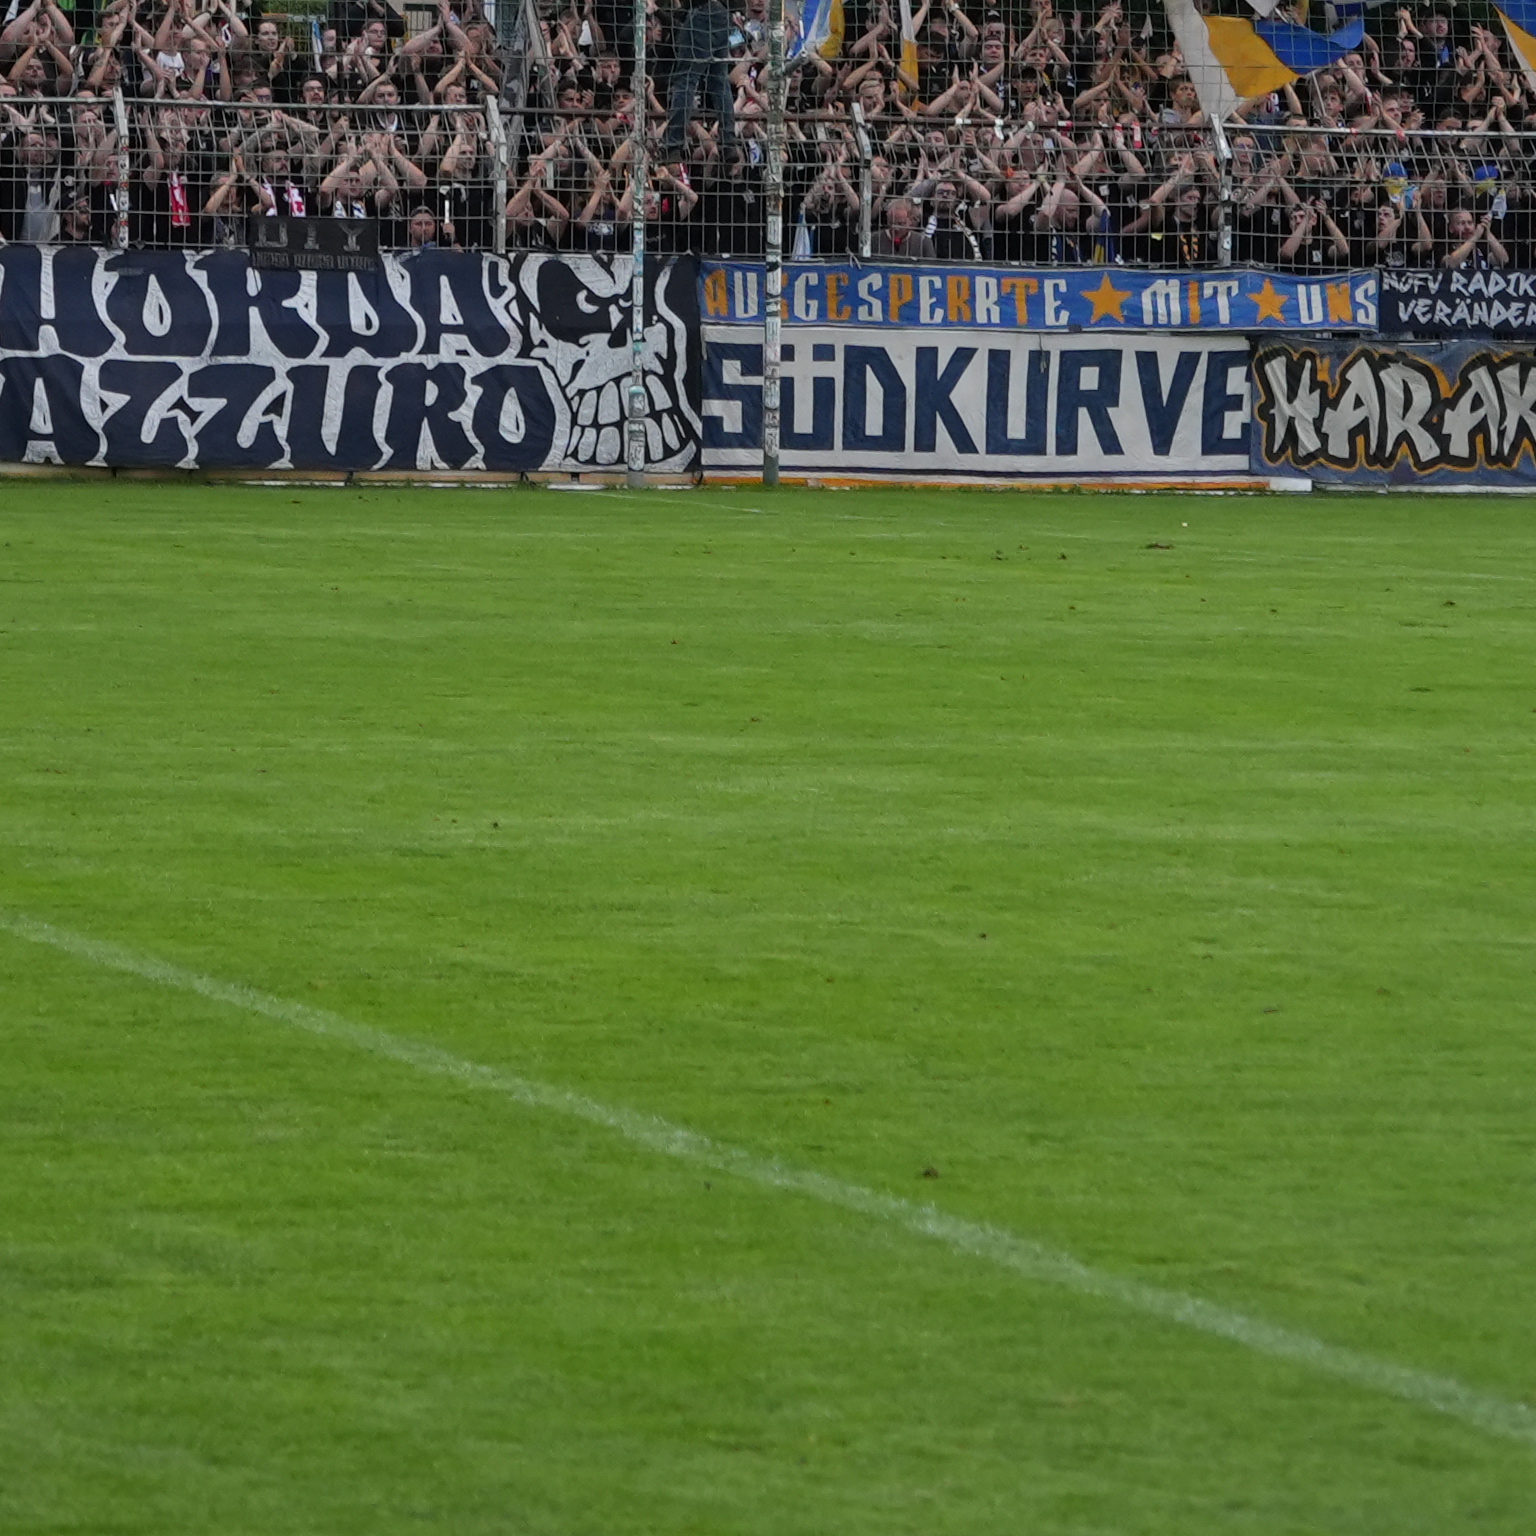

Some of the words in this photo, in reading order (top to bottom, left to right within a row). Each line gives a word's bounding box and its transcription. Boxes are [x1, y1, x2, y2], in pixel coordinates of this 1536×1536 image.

[703, 267, 1070, 326] AUGESPERRTE
[1141, 277, 1239, 326] MIT
[1297, 275, 1378, 328] UNS
[702, 341, 1252, 458] SÜDKURVE
